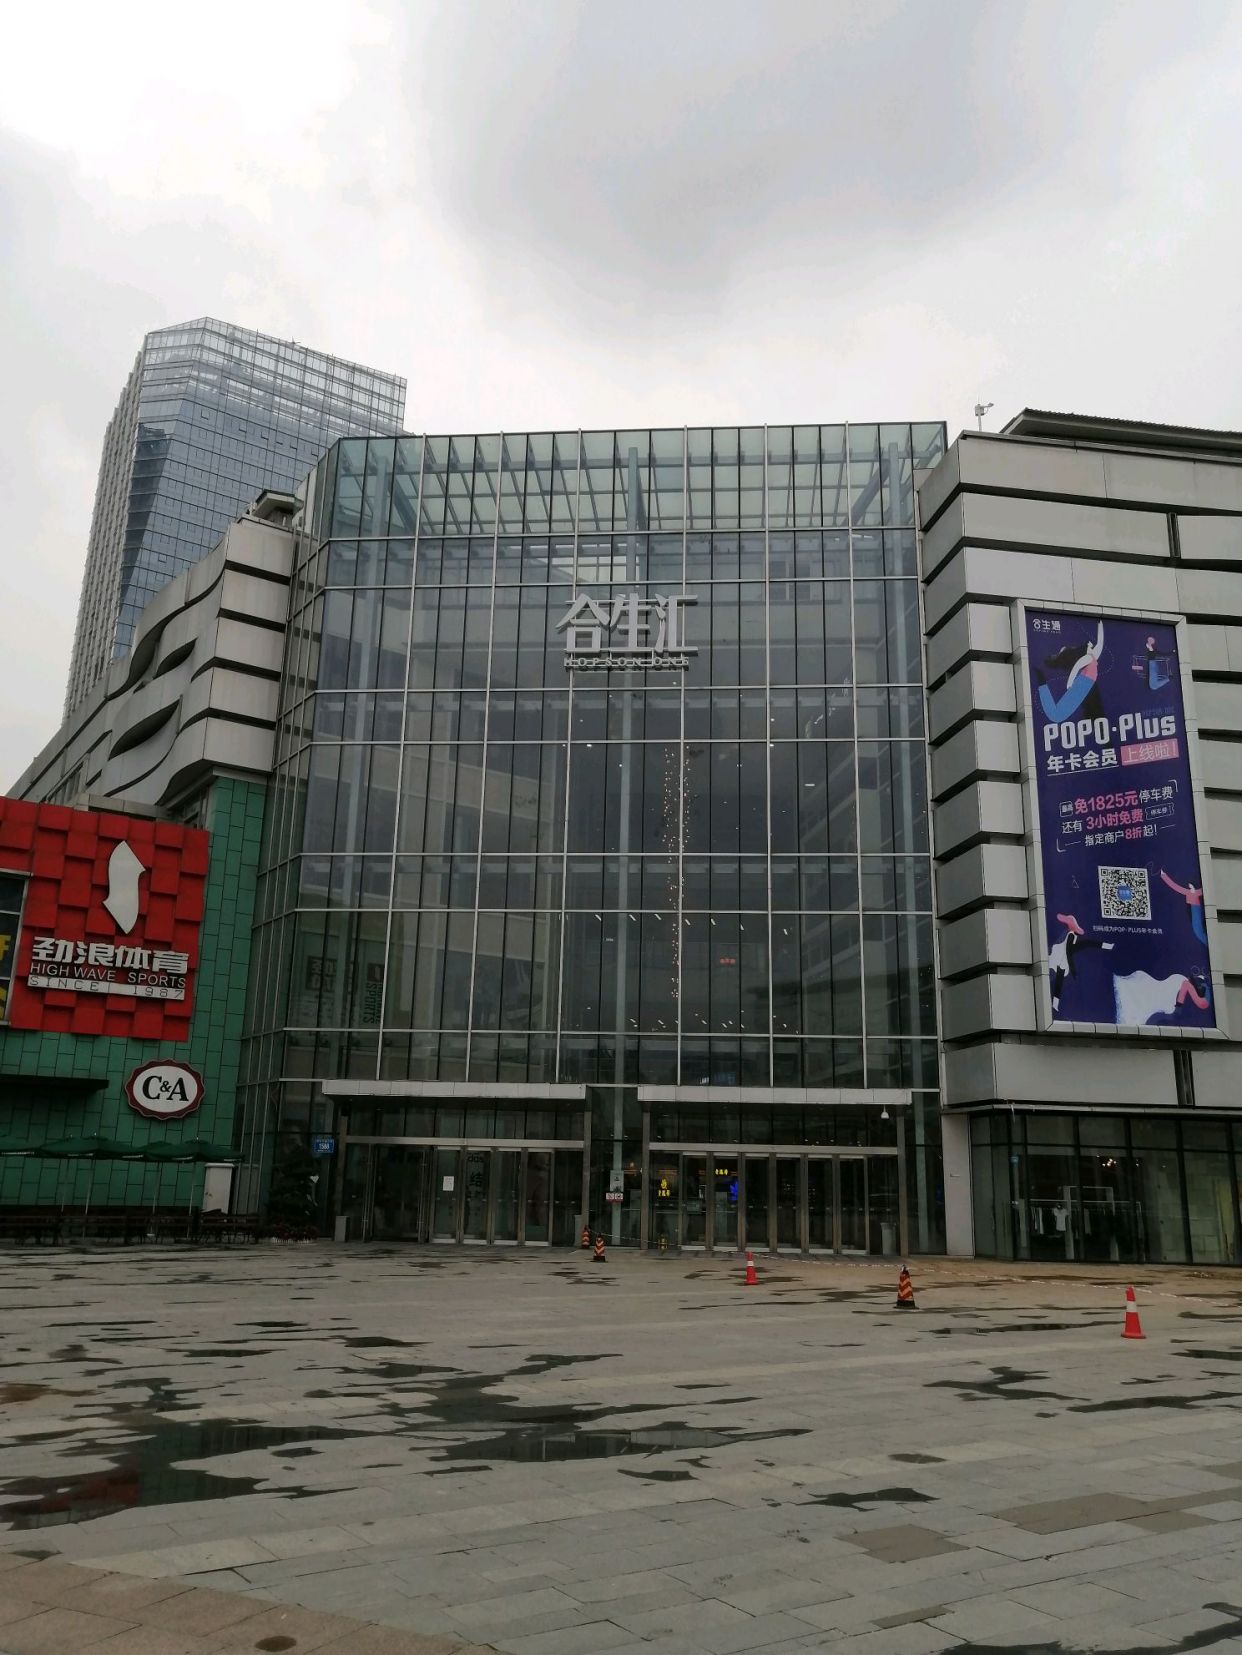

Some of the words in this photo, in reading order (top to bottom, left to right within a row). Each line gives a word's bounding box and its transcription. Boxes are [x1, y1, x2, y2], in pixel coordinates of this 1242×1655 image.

[555, 593, 698, 653] 合生汇
[564, 657, 642, 667] HOPSON
[653, 656, 689, 667] ONE
[1046, 748, 1118, 773] 年卡会员
[32, 936, 189, 974] 劲浪体育
[29, 976, 99, 991] SINCE
[133, 986, 185, 999] 1987
[30, 962, 70, 977] HIGH
[75, 967, 117, 982] WAVE
[127, 972, 187, 988] SPORTS
[142, 1075, 189, 1102] C&A
